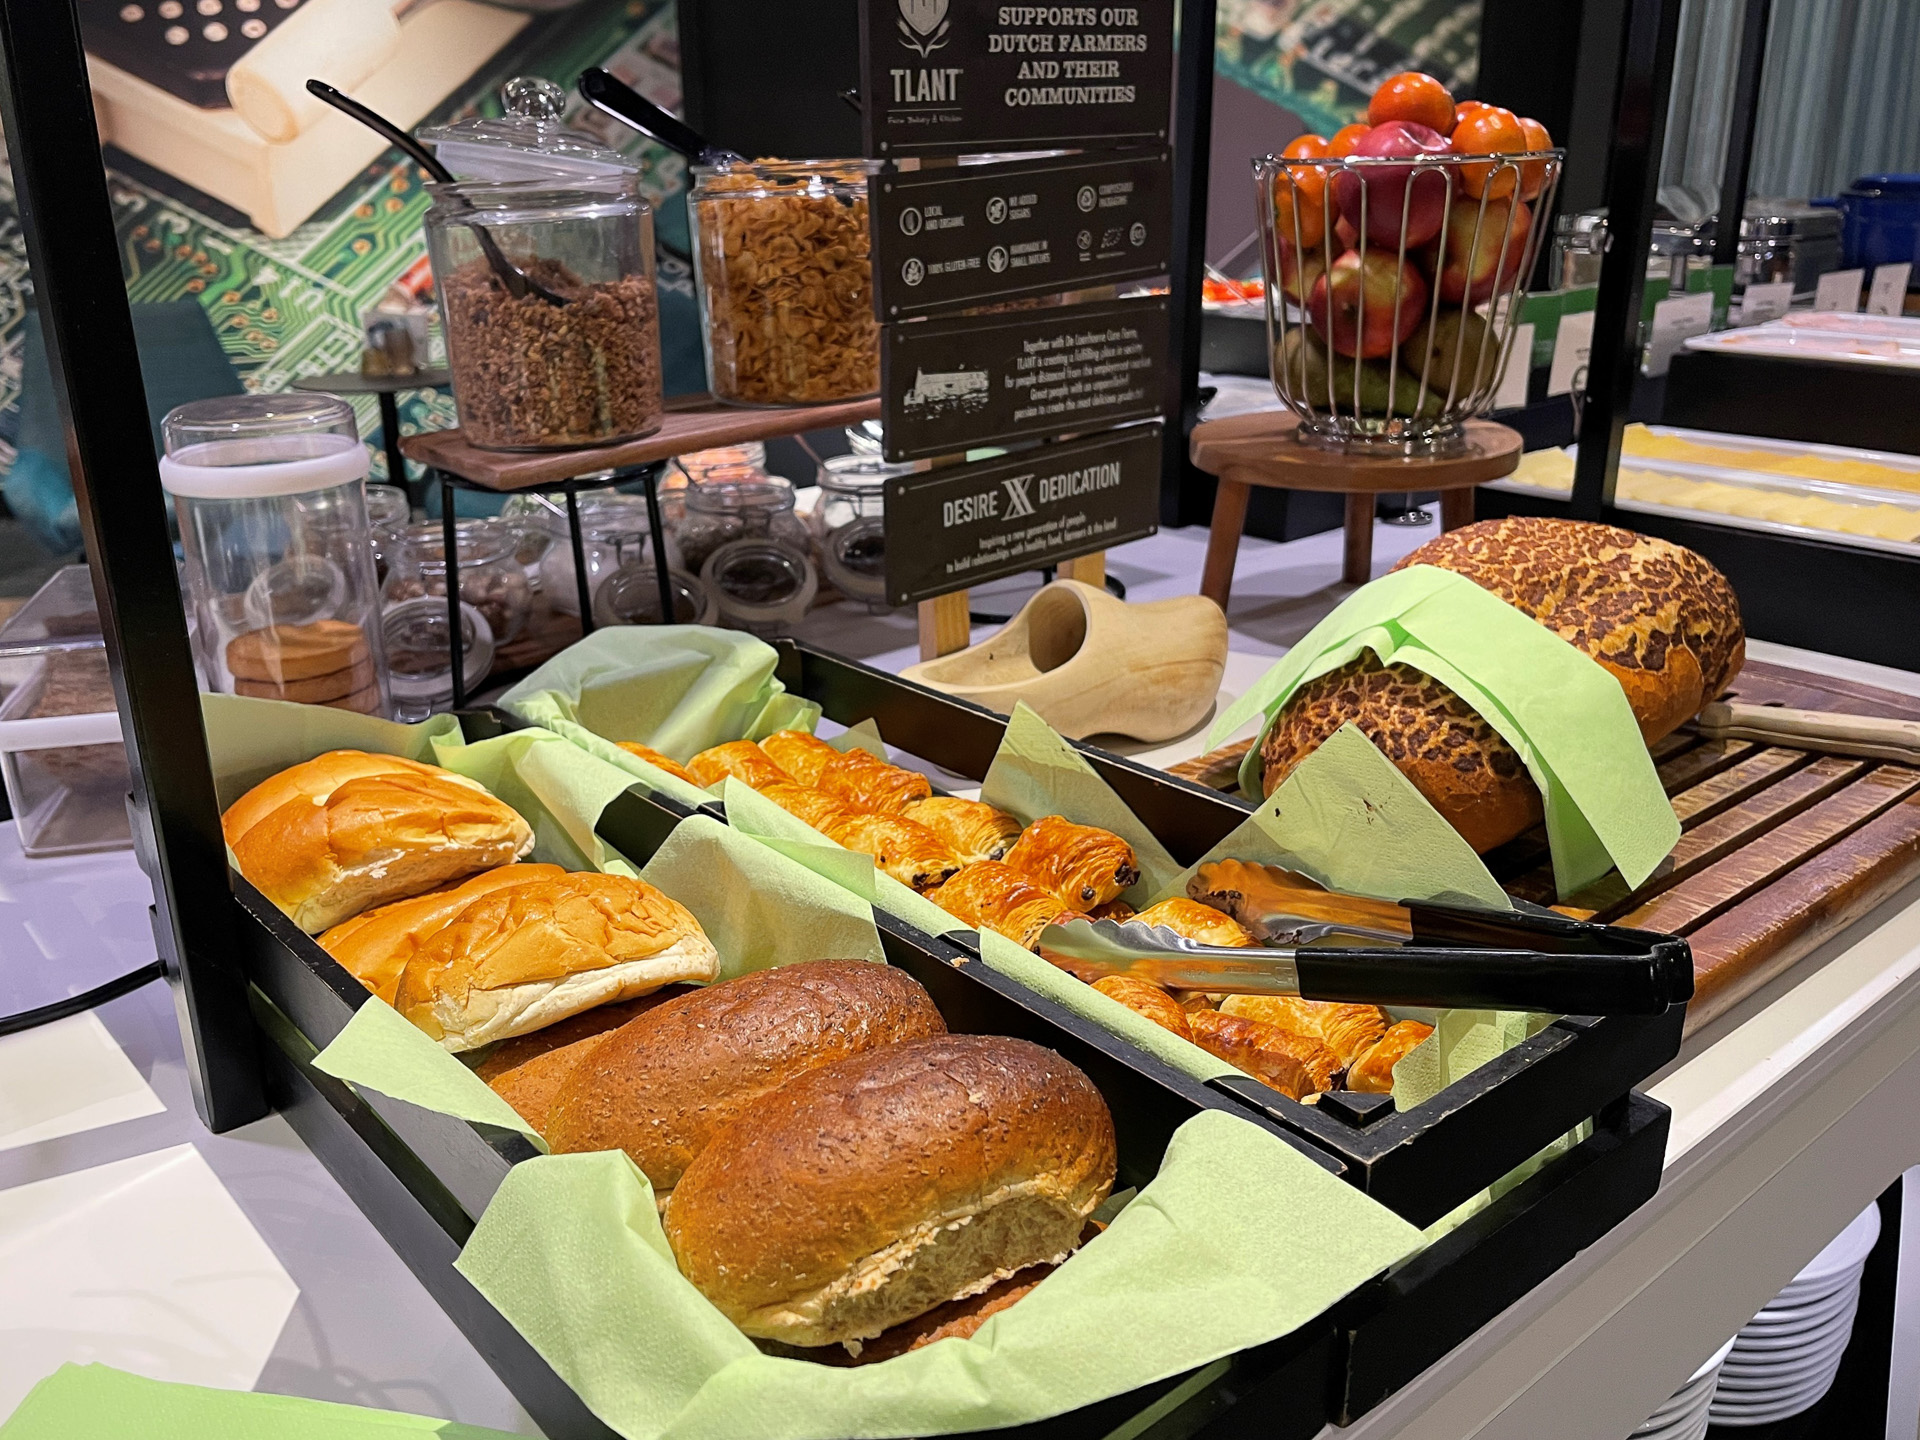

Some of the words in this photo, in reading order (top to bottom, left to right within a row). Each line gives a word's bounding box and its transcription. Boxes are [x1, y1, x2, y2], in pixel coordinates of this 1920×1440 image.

[998, 7, 1097, 26] SUPPORTS
[1100, 8, 1139, 26] OUR
[988, 35, 1054, 53] DUTCH
[1058, 34, 1147, 52] FARMERS
[1017, 61, 1059, 79] AND
[1063, 60, 1120, 78] THEIR
[890, 68, 959, 102] TLANT
[1005, 86, 1135, 106] COMMUNITIES
[943, 490, 999, 528] DESIRE
[1039, 461, 1120, 504] DEDICATION
